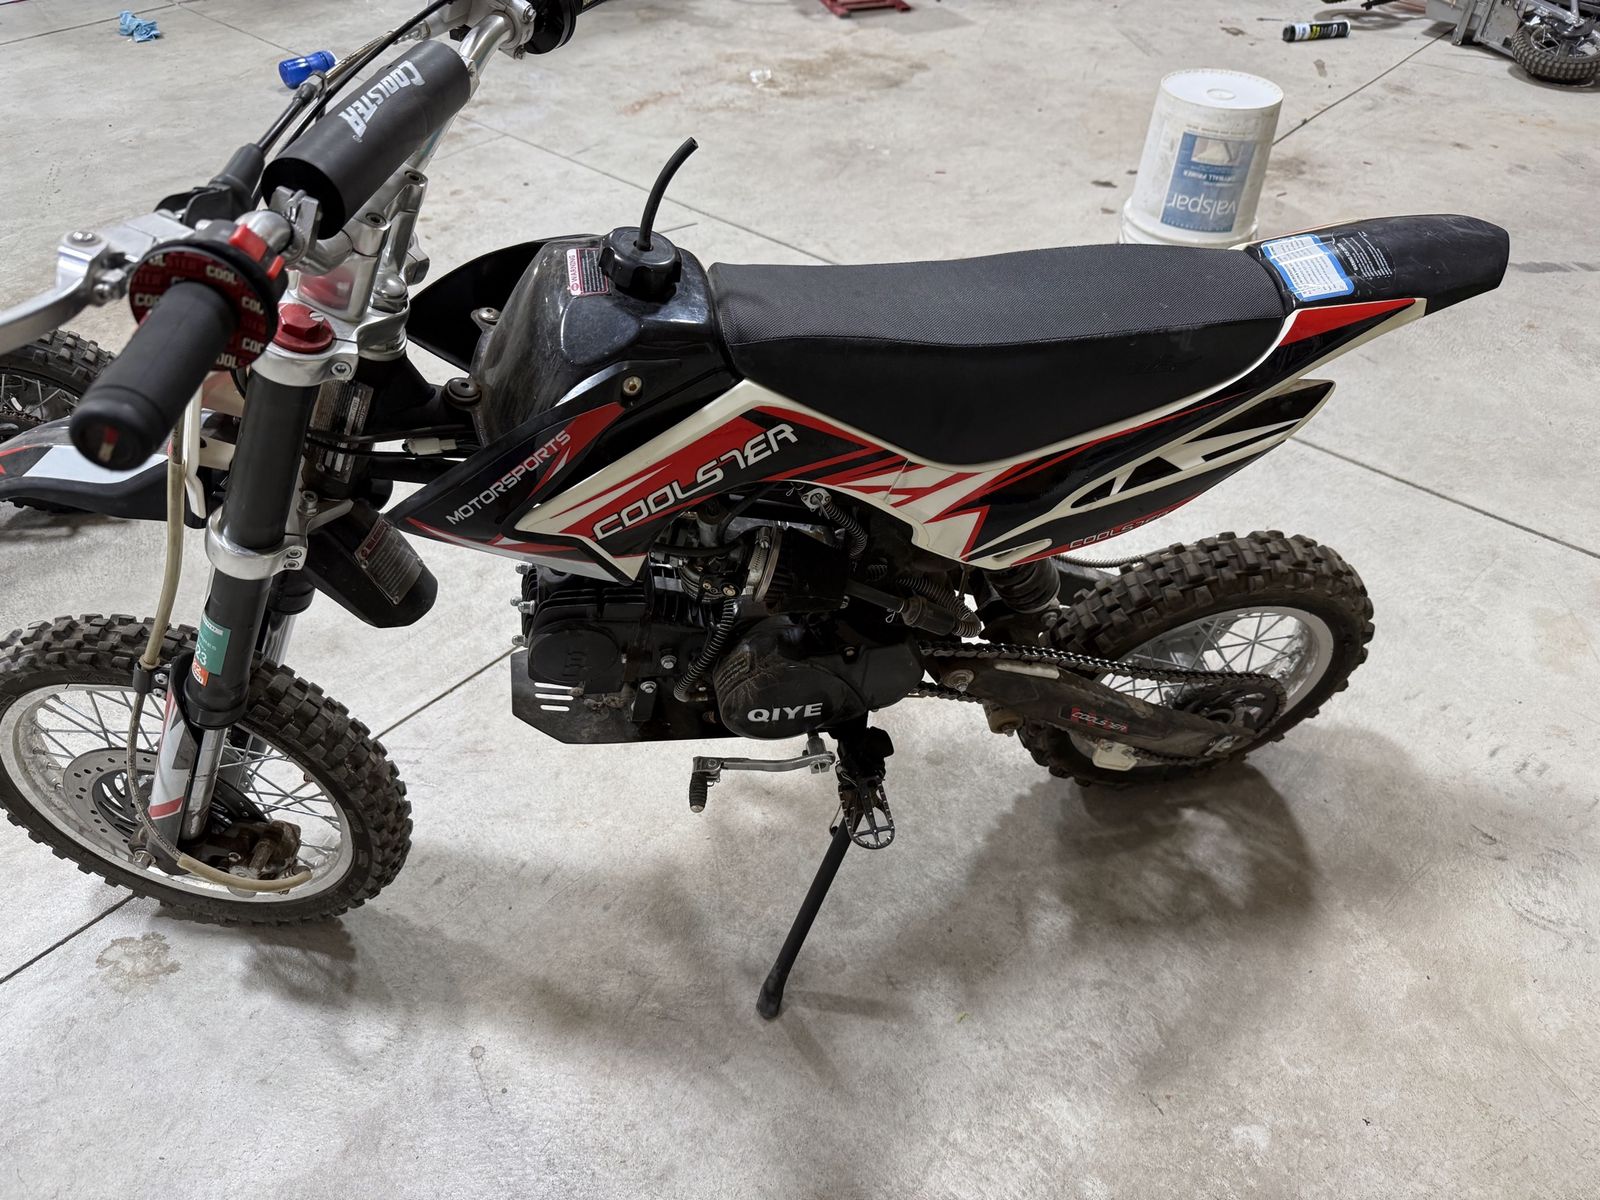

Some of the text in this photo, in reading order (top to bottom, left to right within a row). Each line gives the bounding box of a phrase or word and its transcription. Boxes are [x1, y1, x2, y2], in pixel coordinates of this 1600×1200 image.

[338, 60, 426, 137] COOLSTER
[1166, 192, 1236, 220] valspar
[206, 264, 238, 285] COOL
[569, 255, 578, 283] WARNING
[445, 429, 572, 526] MOTORSPORTS
[592, 422, 799, 541] COOLSTER
[746, 702, 825, 723] QIYE
